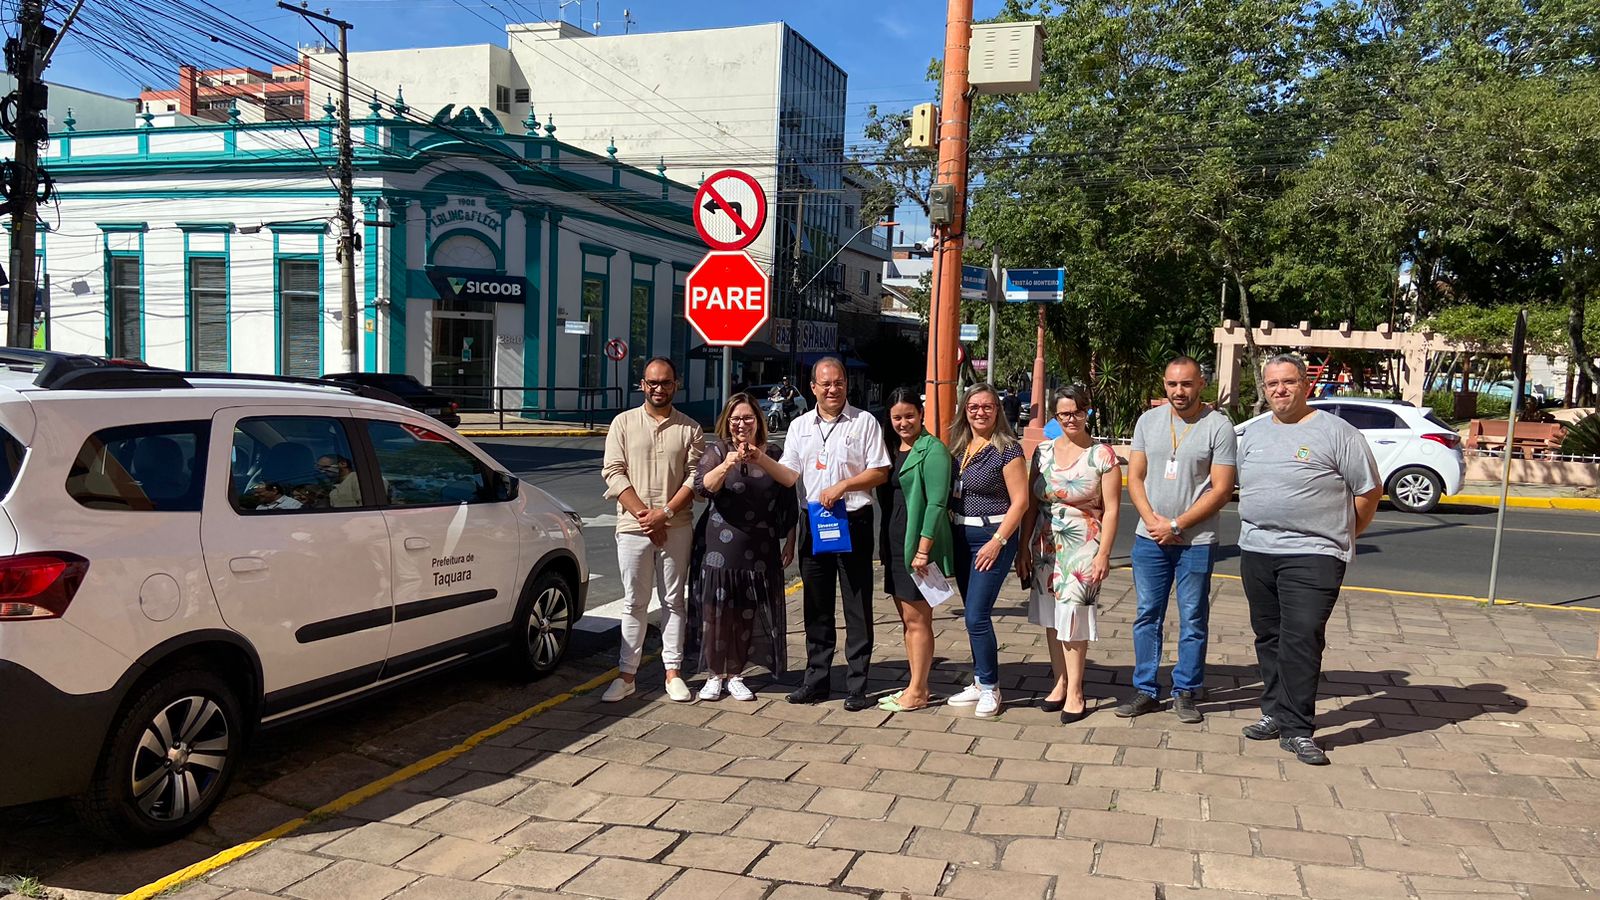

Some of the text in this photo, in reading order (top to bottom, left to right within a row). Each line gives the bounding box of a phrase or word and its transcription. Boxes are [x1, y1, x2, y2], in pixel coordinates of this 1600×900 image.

[466, 281, 521, 296] SICOOB
[692, 286, 762, 310] PARE
[498, 335, 523, 344] 2840
[776, 323, 837, 348] BAZR SHALOM
[432, 553, 474, 567] Prefeitura de
[433, 570, 472, 587] Taquara
